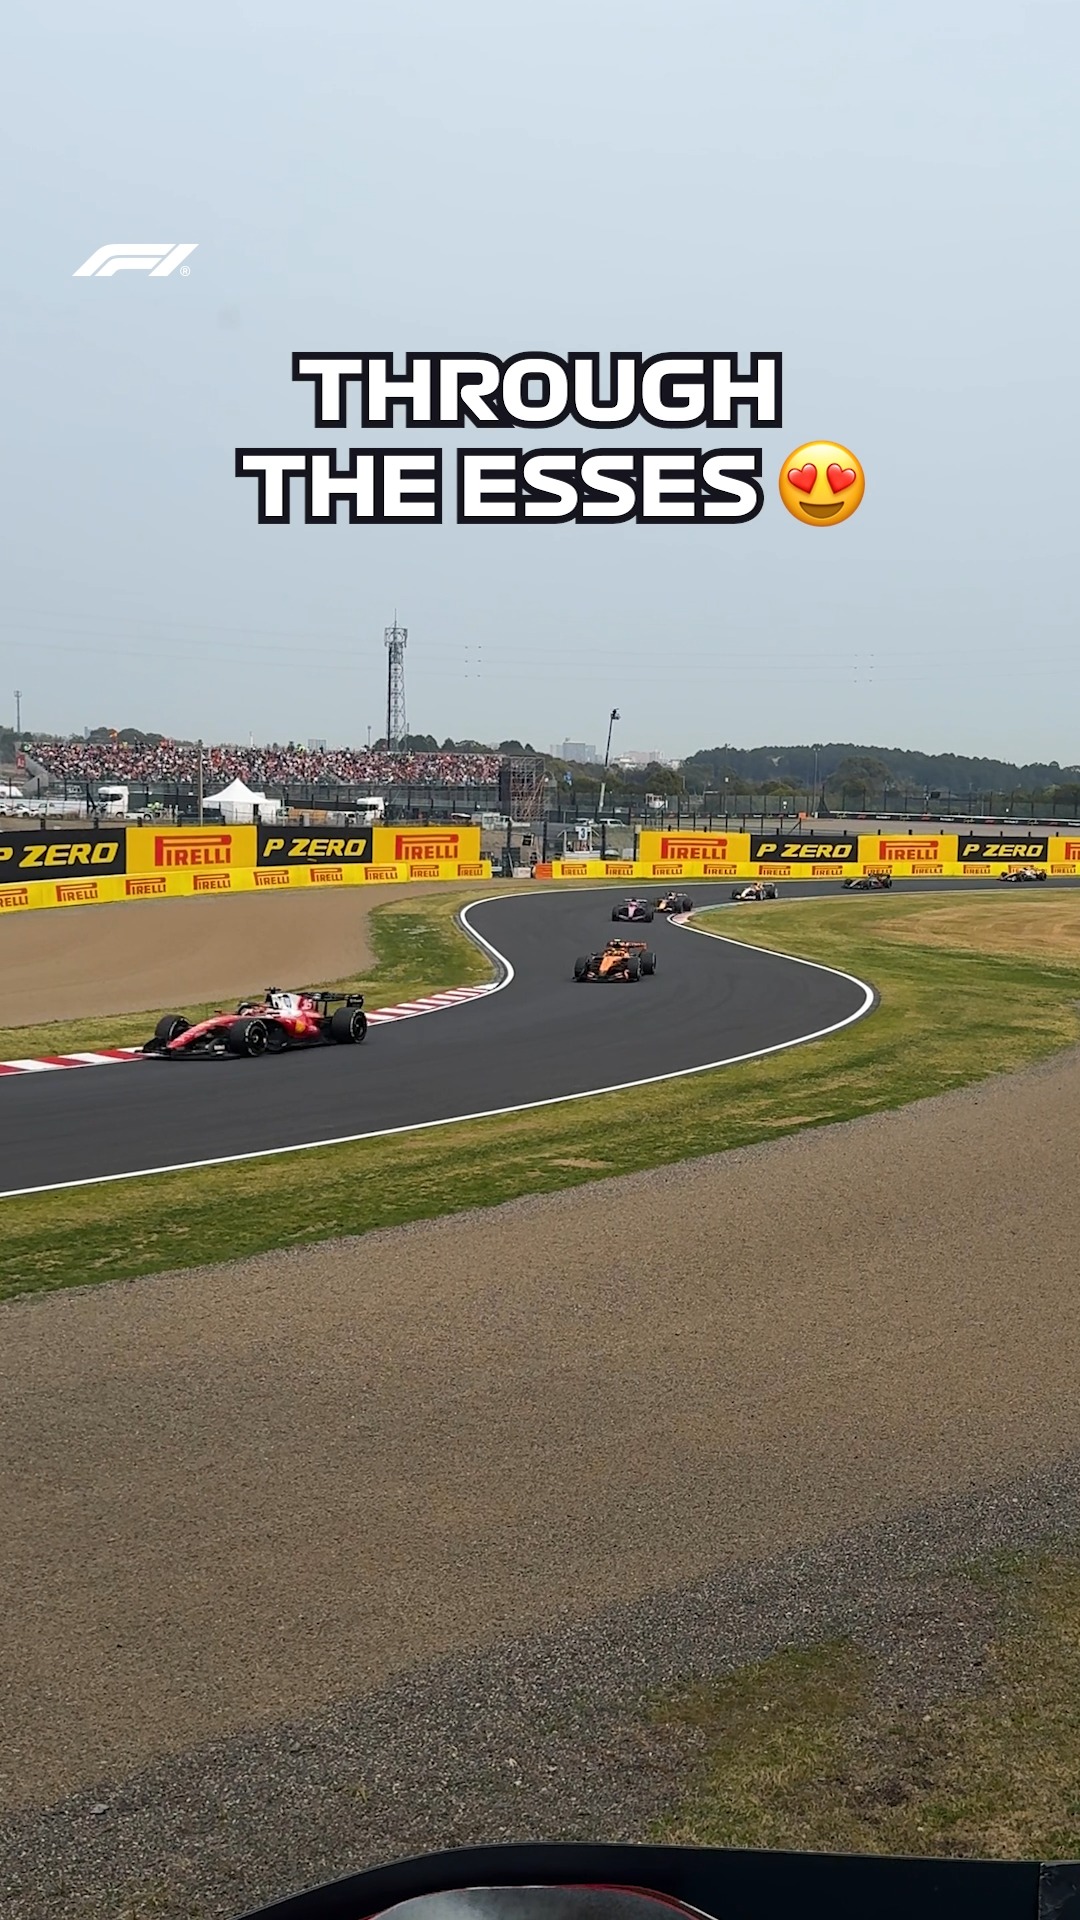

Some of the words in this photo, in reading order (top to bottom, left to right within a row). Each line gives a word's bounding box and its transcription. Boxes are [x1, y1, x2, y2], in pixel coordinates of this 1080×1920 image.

[18, 842, 119, 868] ZERO
[154, 834, 232, 867] PIRELLI
[263, 838, 284, 857] P
[288, 838, 367, 857] ZERO
[395, 834, 459, 860] PIRELLI
[661, 837, 727, 859] PIRELLI
[756, 843, 777, 858] P
[780, 843, 853, 858] ZERO
[879, 840, 939, 860] PIRELLI
[962, 843, 980, 857] P
[982, 843, 1044, 858] ZERO
[254, 869, 290, 886] PIRELLI
[310, 867, 343, 882] PIRELLI
[364, 866, 398, 881] PIRELLI
[410, 864, 439, 877] PIRELLI
[457, 864, 483, 876] PIRELLI
[561, 864, 587, 876] PIRELLI
[605, 864, 633, 876] PIRELLI
[652, 864, 683, 876] PIRELLI
[703, 864, 737, 876] PIRELLI
[758, 865, 791, 876] PIRELLI
[126, 877, 167, 895] PIRELLI
[193, 873, 231, 891] PIRELLI
[0, 887, 29, 907] RELLI
[56, 881, 98, 902] PIRELLI
